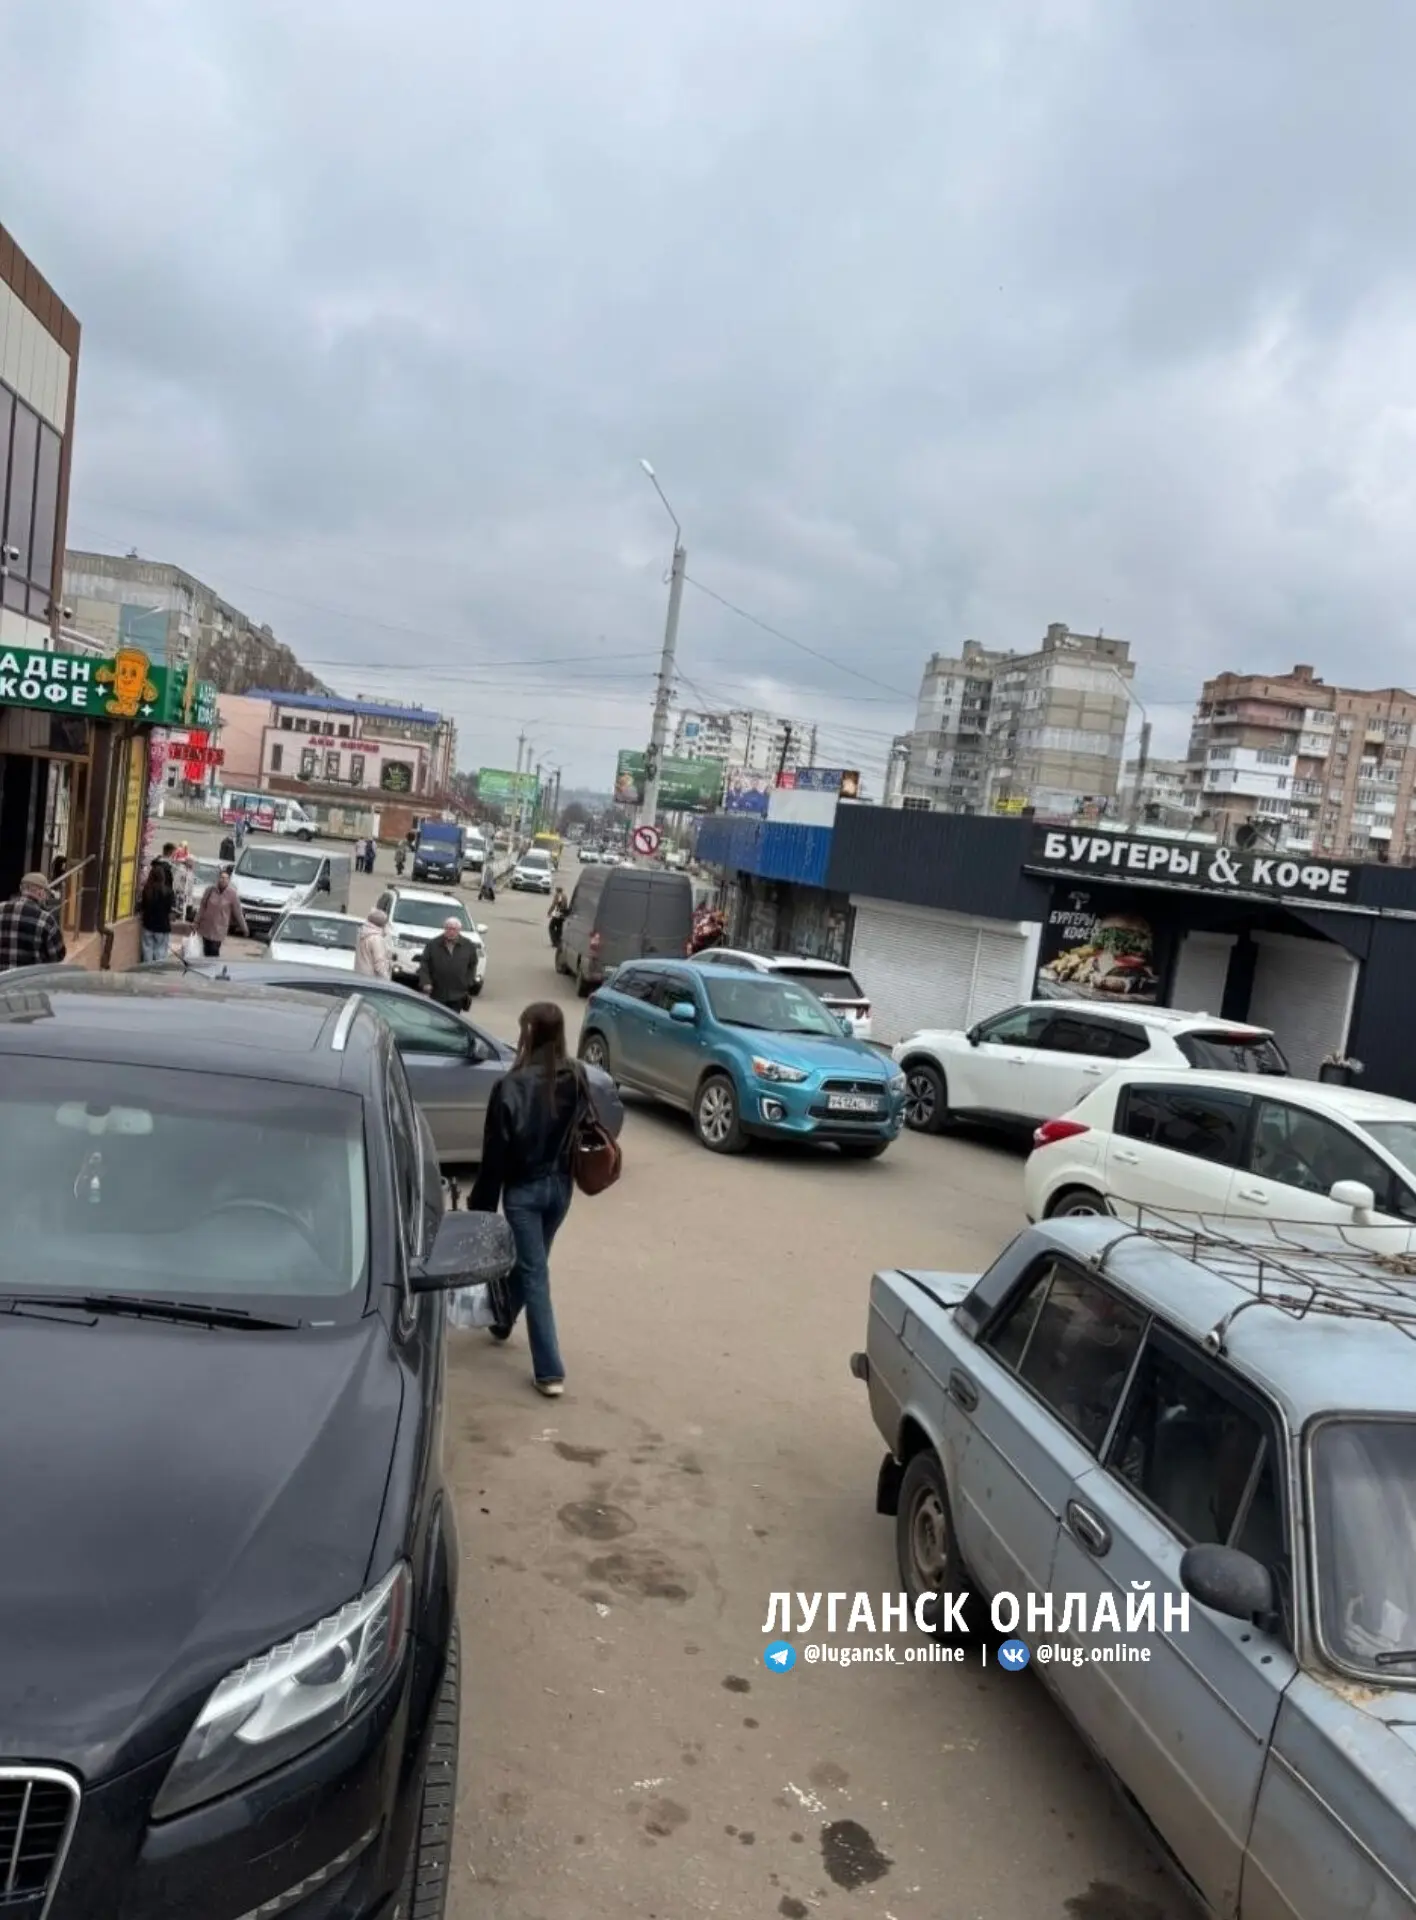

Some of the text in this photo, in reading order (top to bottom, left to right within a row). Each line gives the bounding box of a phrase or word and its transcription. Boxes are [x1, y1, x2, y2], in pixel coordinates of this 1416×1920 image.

[0, 652, 90, 682] АДЕН
[0, 676, 88, 706] КОФЕ
[1043, 832, 1350, 895] БУРГЕРЫ & КОФЕ
[1049, 910, 1097, 926] БУРГЕРЫ
